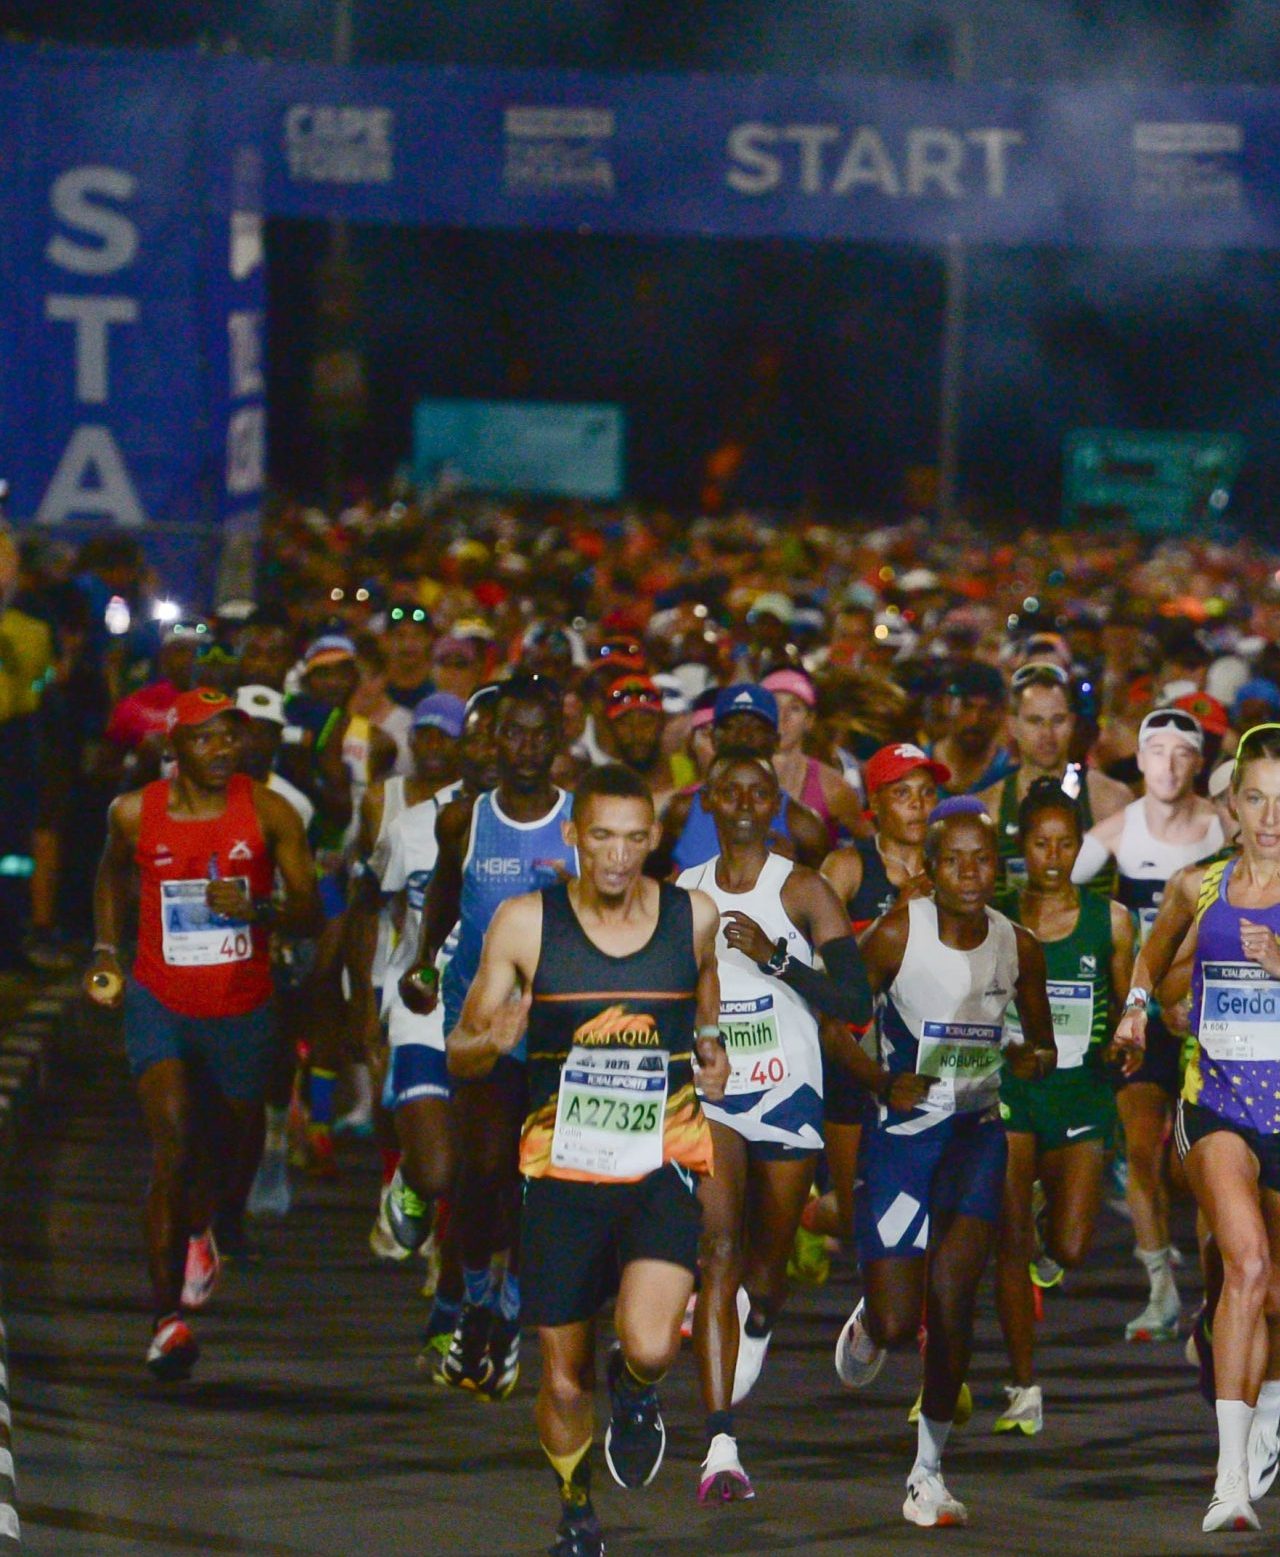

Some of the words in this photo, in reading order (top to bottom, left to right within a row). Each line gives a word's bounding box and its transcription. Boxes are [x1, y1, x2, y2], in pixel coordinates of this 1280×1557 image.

[727, 121, 1025, 197] START
[220, 933, 248, 959] 40
[1216, 991, 1276, 1015] Gerda
[750, 1056, 785, 1086] 40
[565, 1095, 659, 1132] A27325
